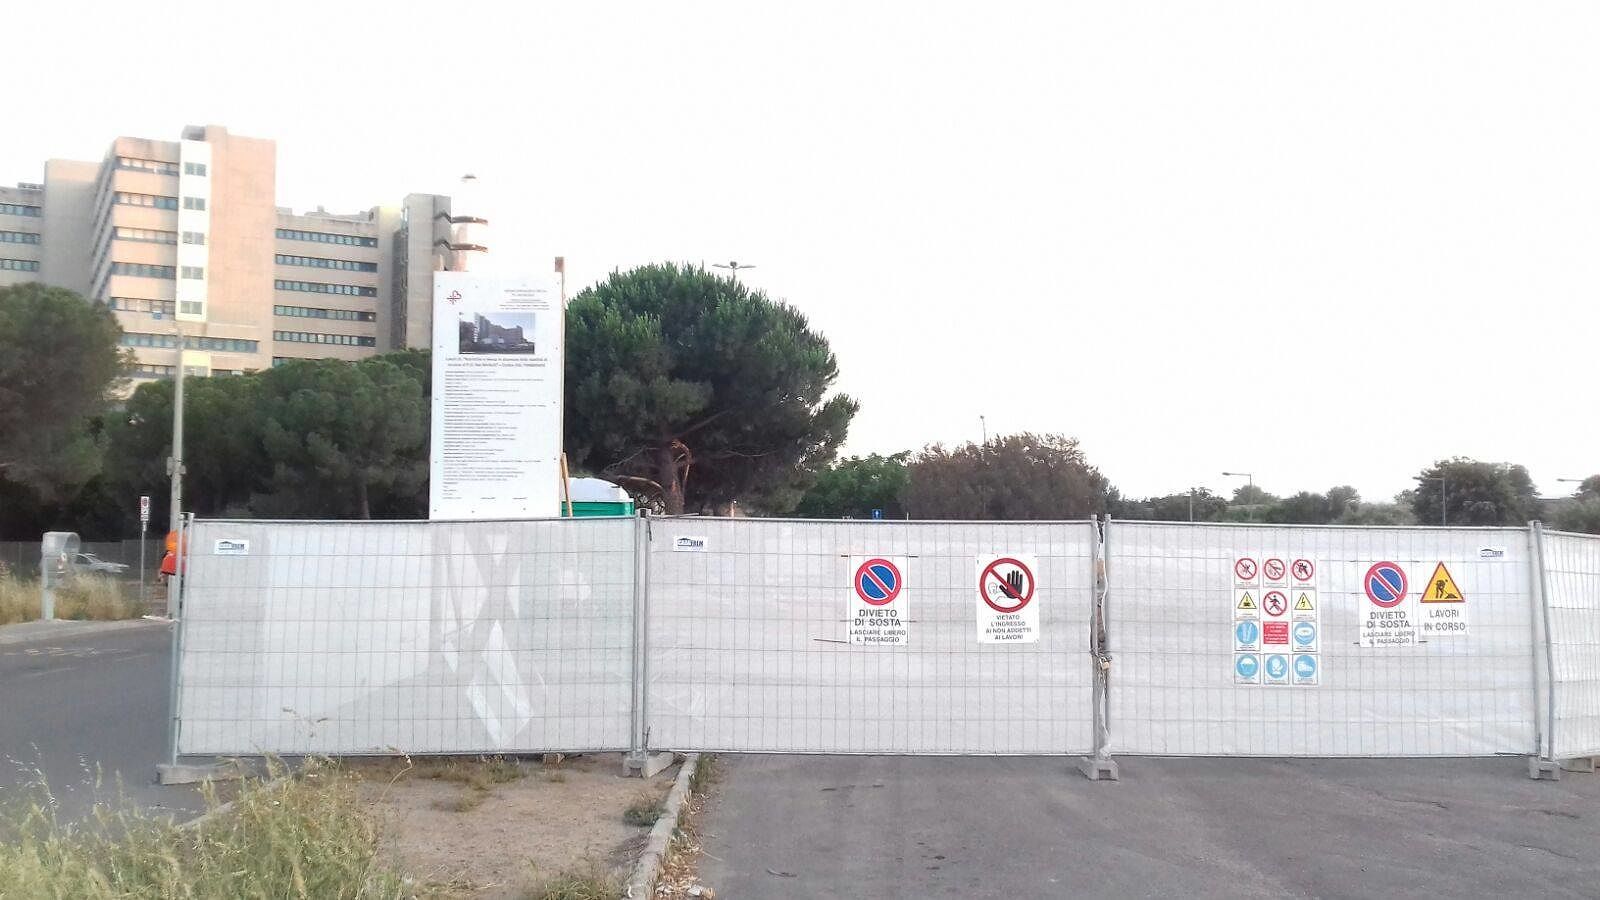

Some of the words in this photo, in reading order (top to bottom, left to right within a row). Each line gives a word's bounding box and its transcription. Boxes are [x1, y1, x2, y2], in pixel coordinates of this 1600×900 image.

[859, 609, 898, 618] DIVIETO
[1370, 611, 1406, 619] DIVIETO
[1429, 609, 1459, 618] LAVORI
[854, 618, 865, 627] DI
[868, 618, 901, 627] SOSTA
[1366, 620, 1376, 629] DI
[1380, 620, 1411, 629] SOSTA
[1424, 622, 1433, 631] IN
[1435, 622, 1466, 631] CORSO
[1394, 630, 1416, 638] LIBERO
[1376, 637, 1410, 645] PASSAGGIO
